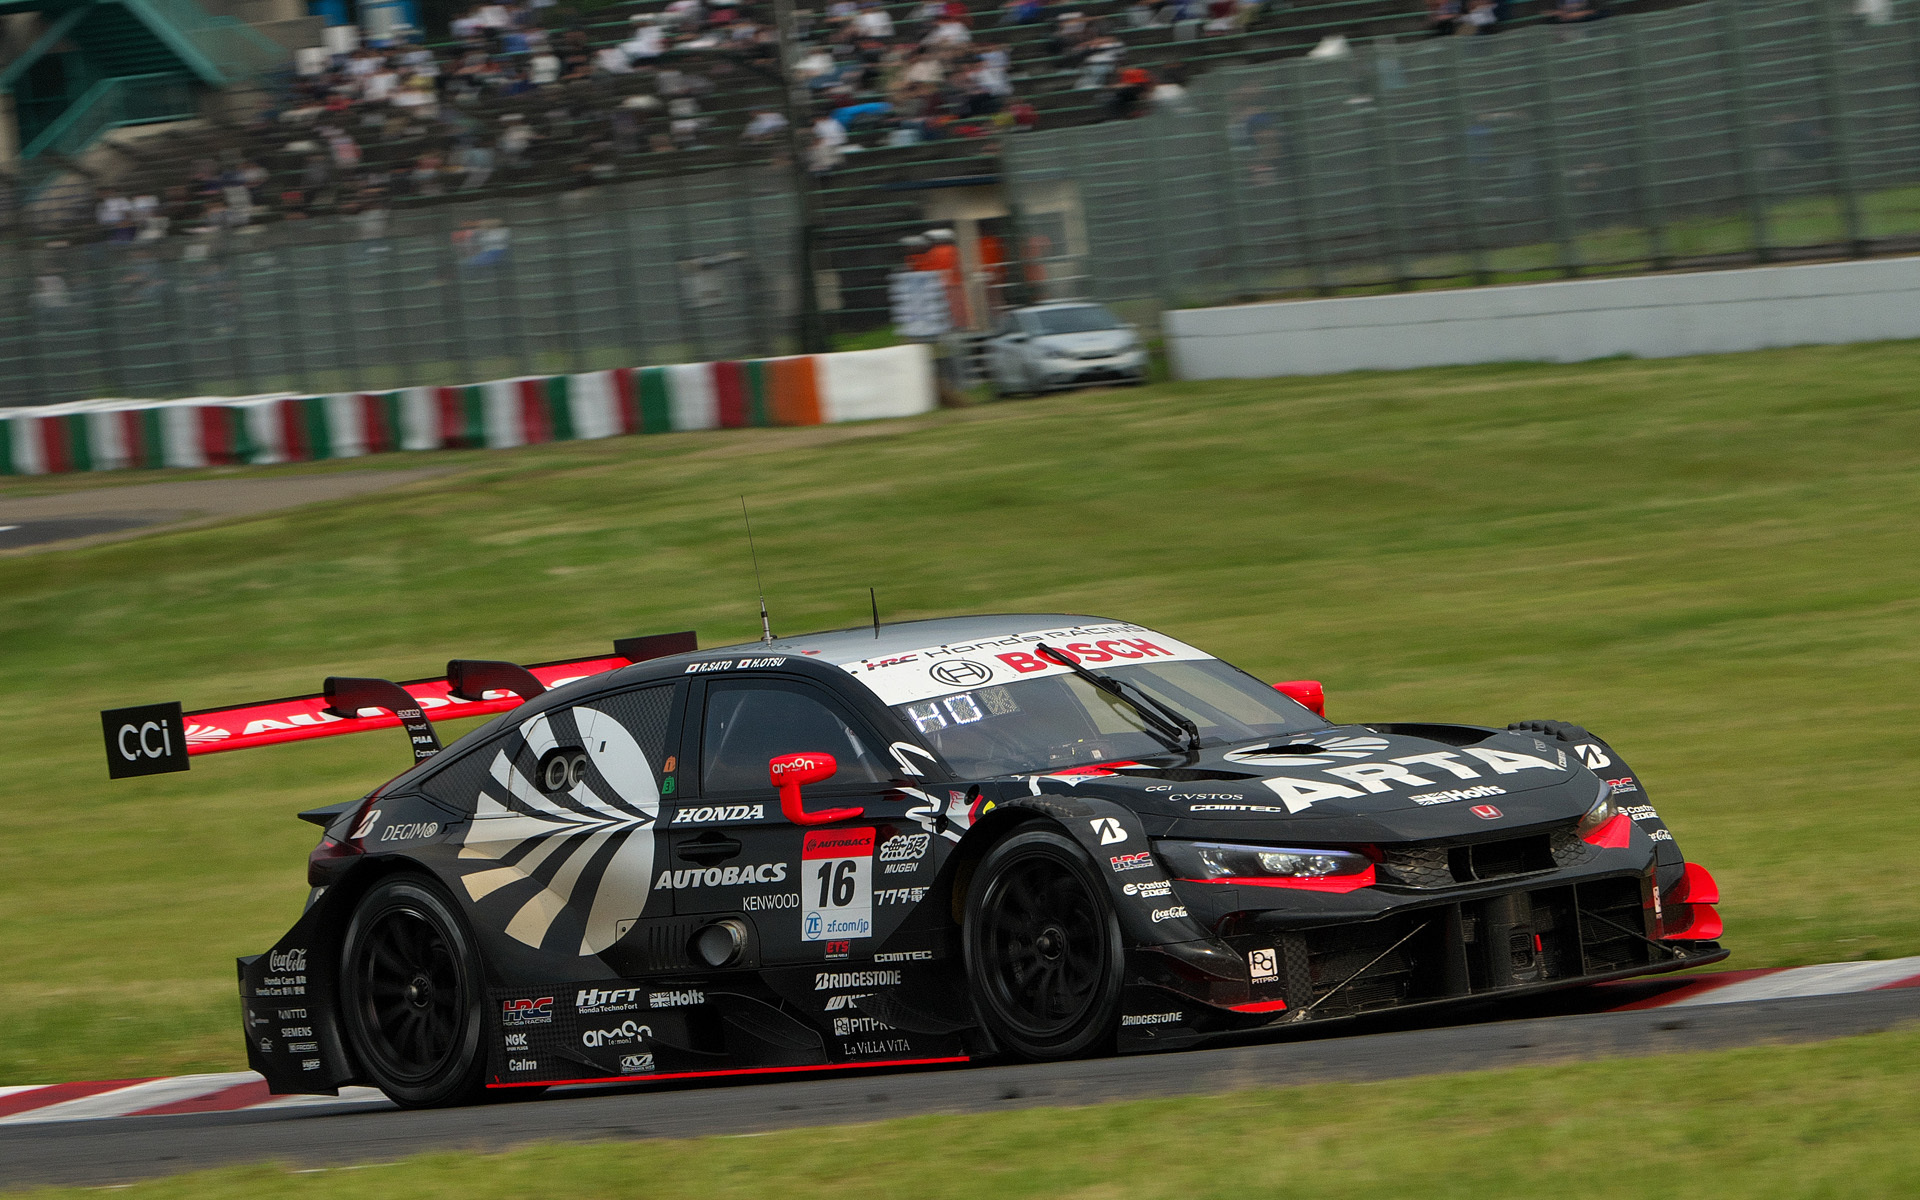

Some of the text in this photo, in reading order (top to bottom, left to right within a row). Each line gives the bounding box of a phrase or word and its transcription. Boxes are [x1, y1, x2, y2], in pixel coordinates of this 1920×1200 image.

[994, 638, 1175, 674] BOSCH
[699, 657, 787, 673] R.SATO H.OTSU
[412, 735, 433, 745] PIAA
[772, 757, 815, 774] amon
[1261, 746, 1568, 815] ARTA
[1168, 793, 1244, 802] CVSTOS
[1444, 786, 1507, 801] Holts
[671, 804, 764, 823] HONDA
[1190, 804, 1281, 813] COMTEC
[818, 838, 872, 849] AUTOBACS
[884, 862, 919, 874] MUGEN
[1110, 851, 1152, 871] HRC
[654, 862, 787, 890] AUTOBACS
[817, 859, 857, 908] 16
[1136, 879, 1171, 891] Castrol
[1140, 888, 1172, 898] EDGE
[743, 893, 800, 911] KENWOOD
[826, 918, 870, 934] zf.com/jp
[826, 940, 849, 954] ETS
[873, 951, 933, 963] COMTEC
[814, 969, 902, 991] BRIDGESTONE
[1251, 975, 1279, 985] PITPRO
[576, 988, 640, 1005] HTFT
[668, 989, 705, 1007] Holts
[502, 996, 554, 1022] HRC
[578, 1006, 600, 1015] Honda
[1122, 1011, 1183, 1026] BRIDGESTONE
[280, 1026, 313, 1038] SIEMENS
[505, 1033, 528, 1047] NGK
[508, 1058, 537, 1072] Calm
